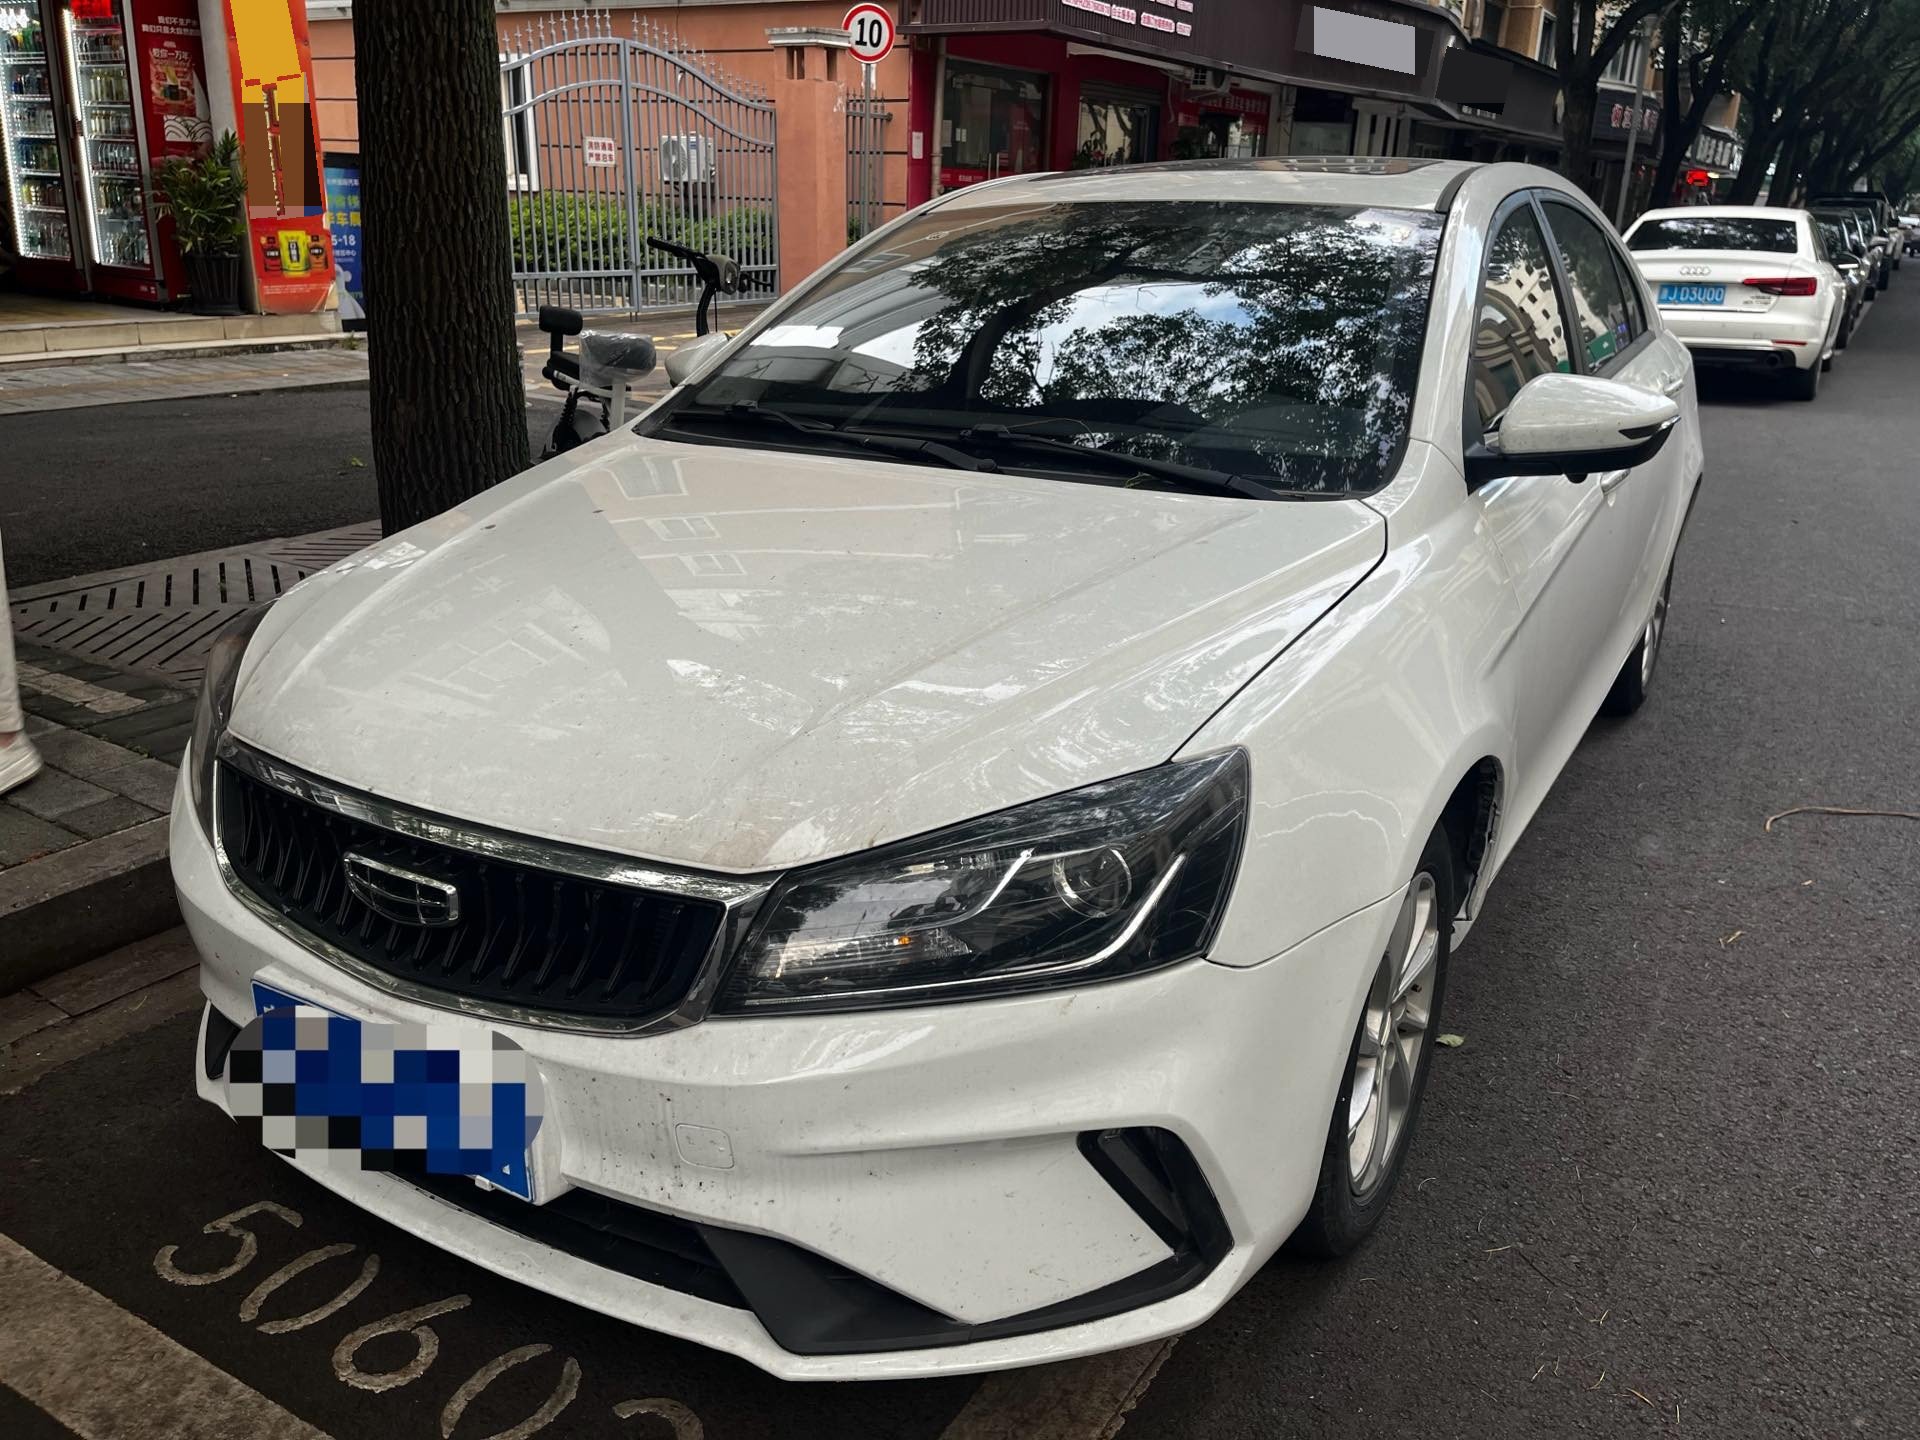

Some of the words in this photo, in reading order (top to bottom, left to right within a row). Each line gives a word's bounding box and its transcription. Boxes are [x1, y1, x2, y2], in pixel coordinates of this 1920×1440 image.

[855, 17, 882, 48] 10
[588, 141, 613, 151] 消防通道
